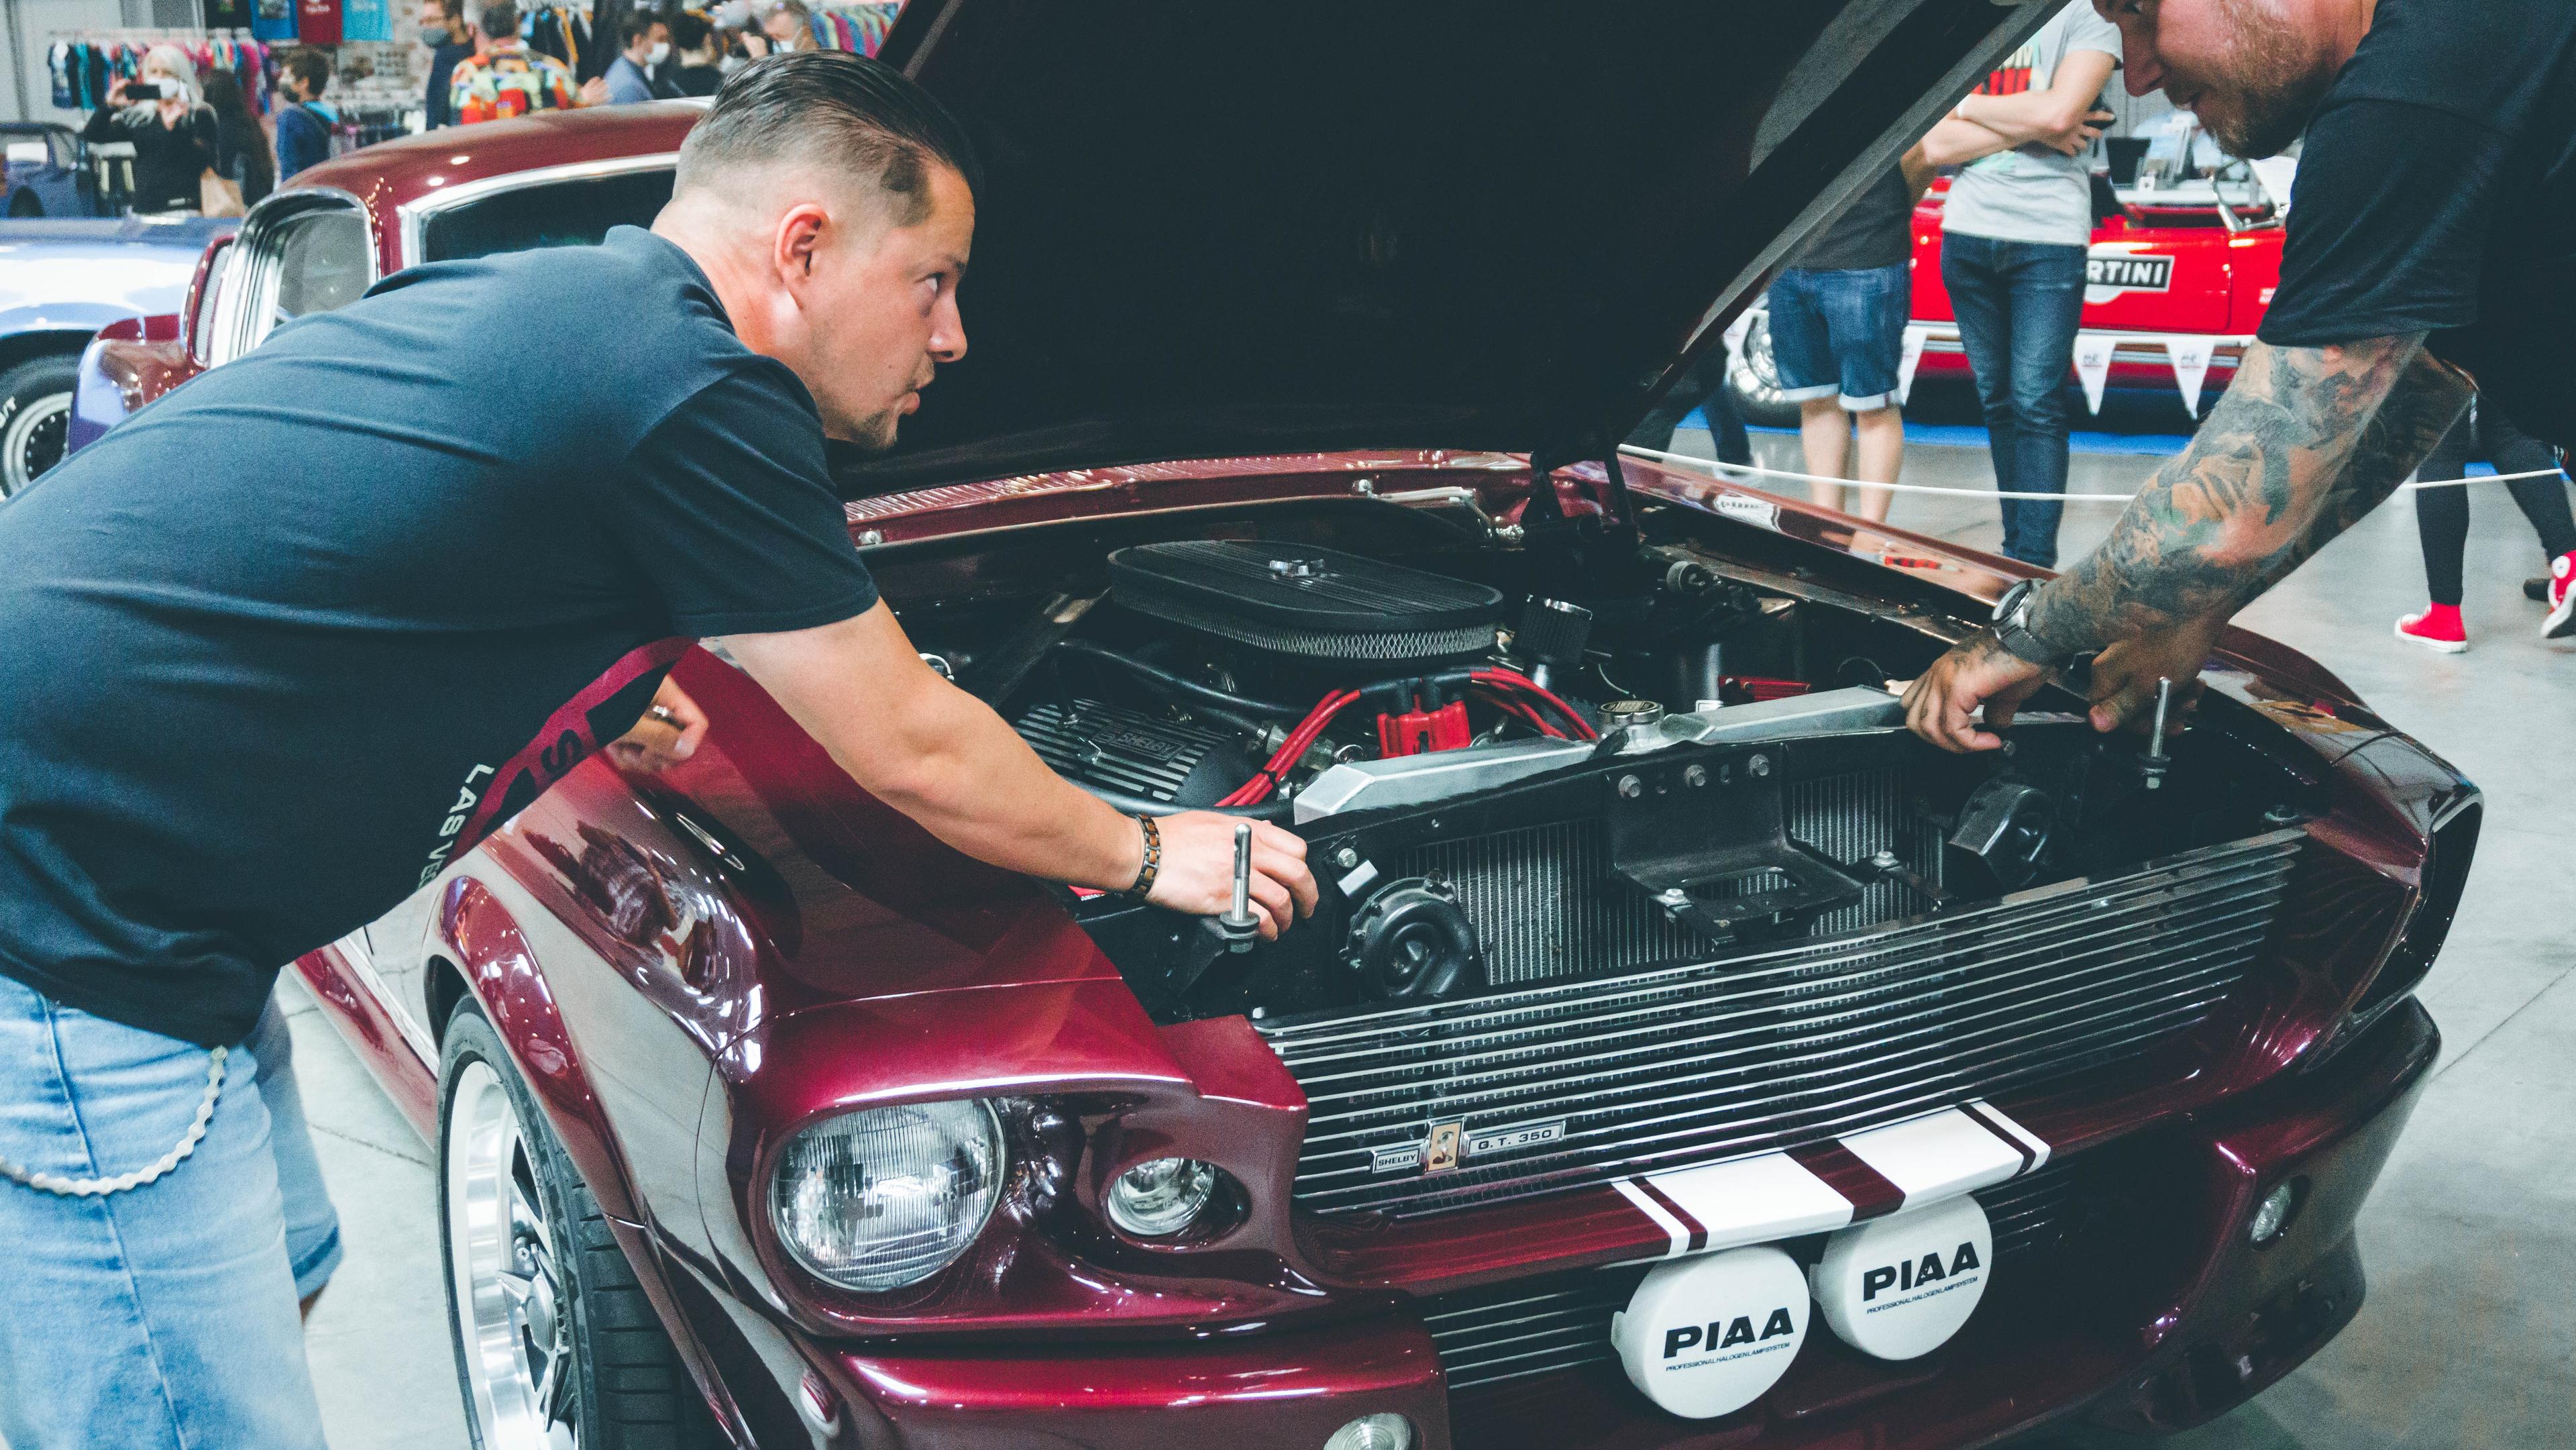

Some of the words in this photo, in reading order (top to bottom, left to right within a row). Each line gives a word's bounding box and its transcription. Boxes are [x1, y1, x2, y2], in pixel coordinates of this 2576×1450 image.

[2087, 260, 2164, 284] RTINI
[439, 764, 495, 837] LAS
[1378, 1153, 1417, 1167] SHELBY
[1518, 1129, 1552, 1143] 350
[1863, 1241, 1980, 1302] PIAA
[1663, 1306, 1794, 1359] PIAA
